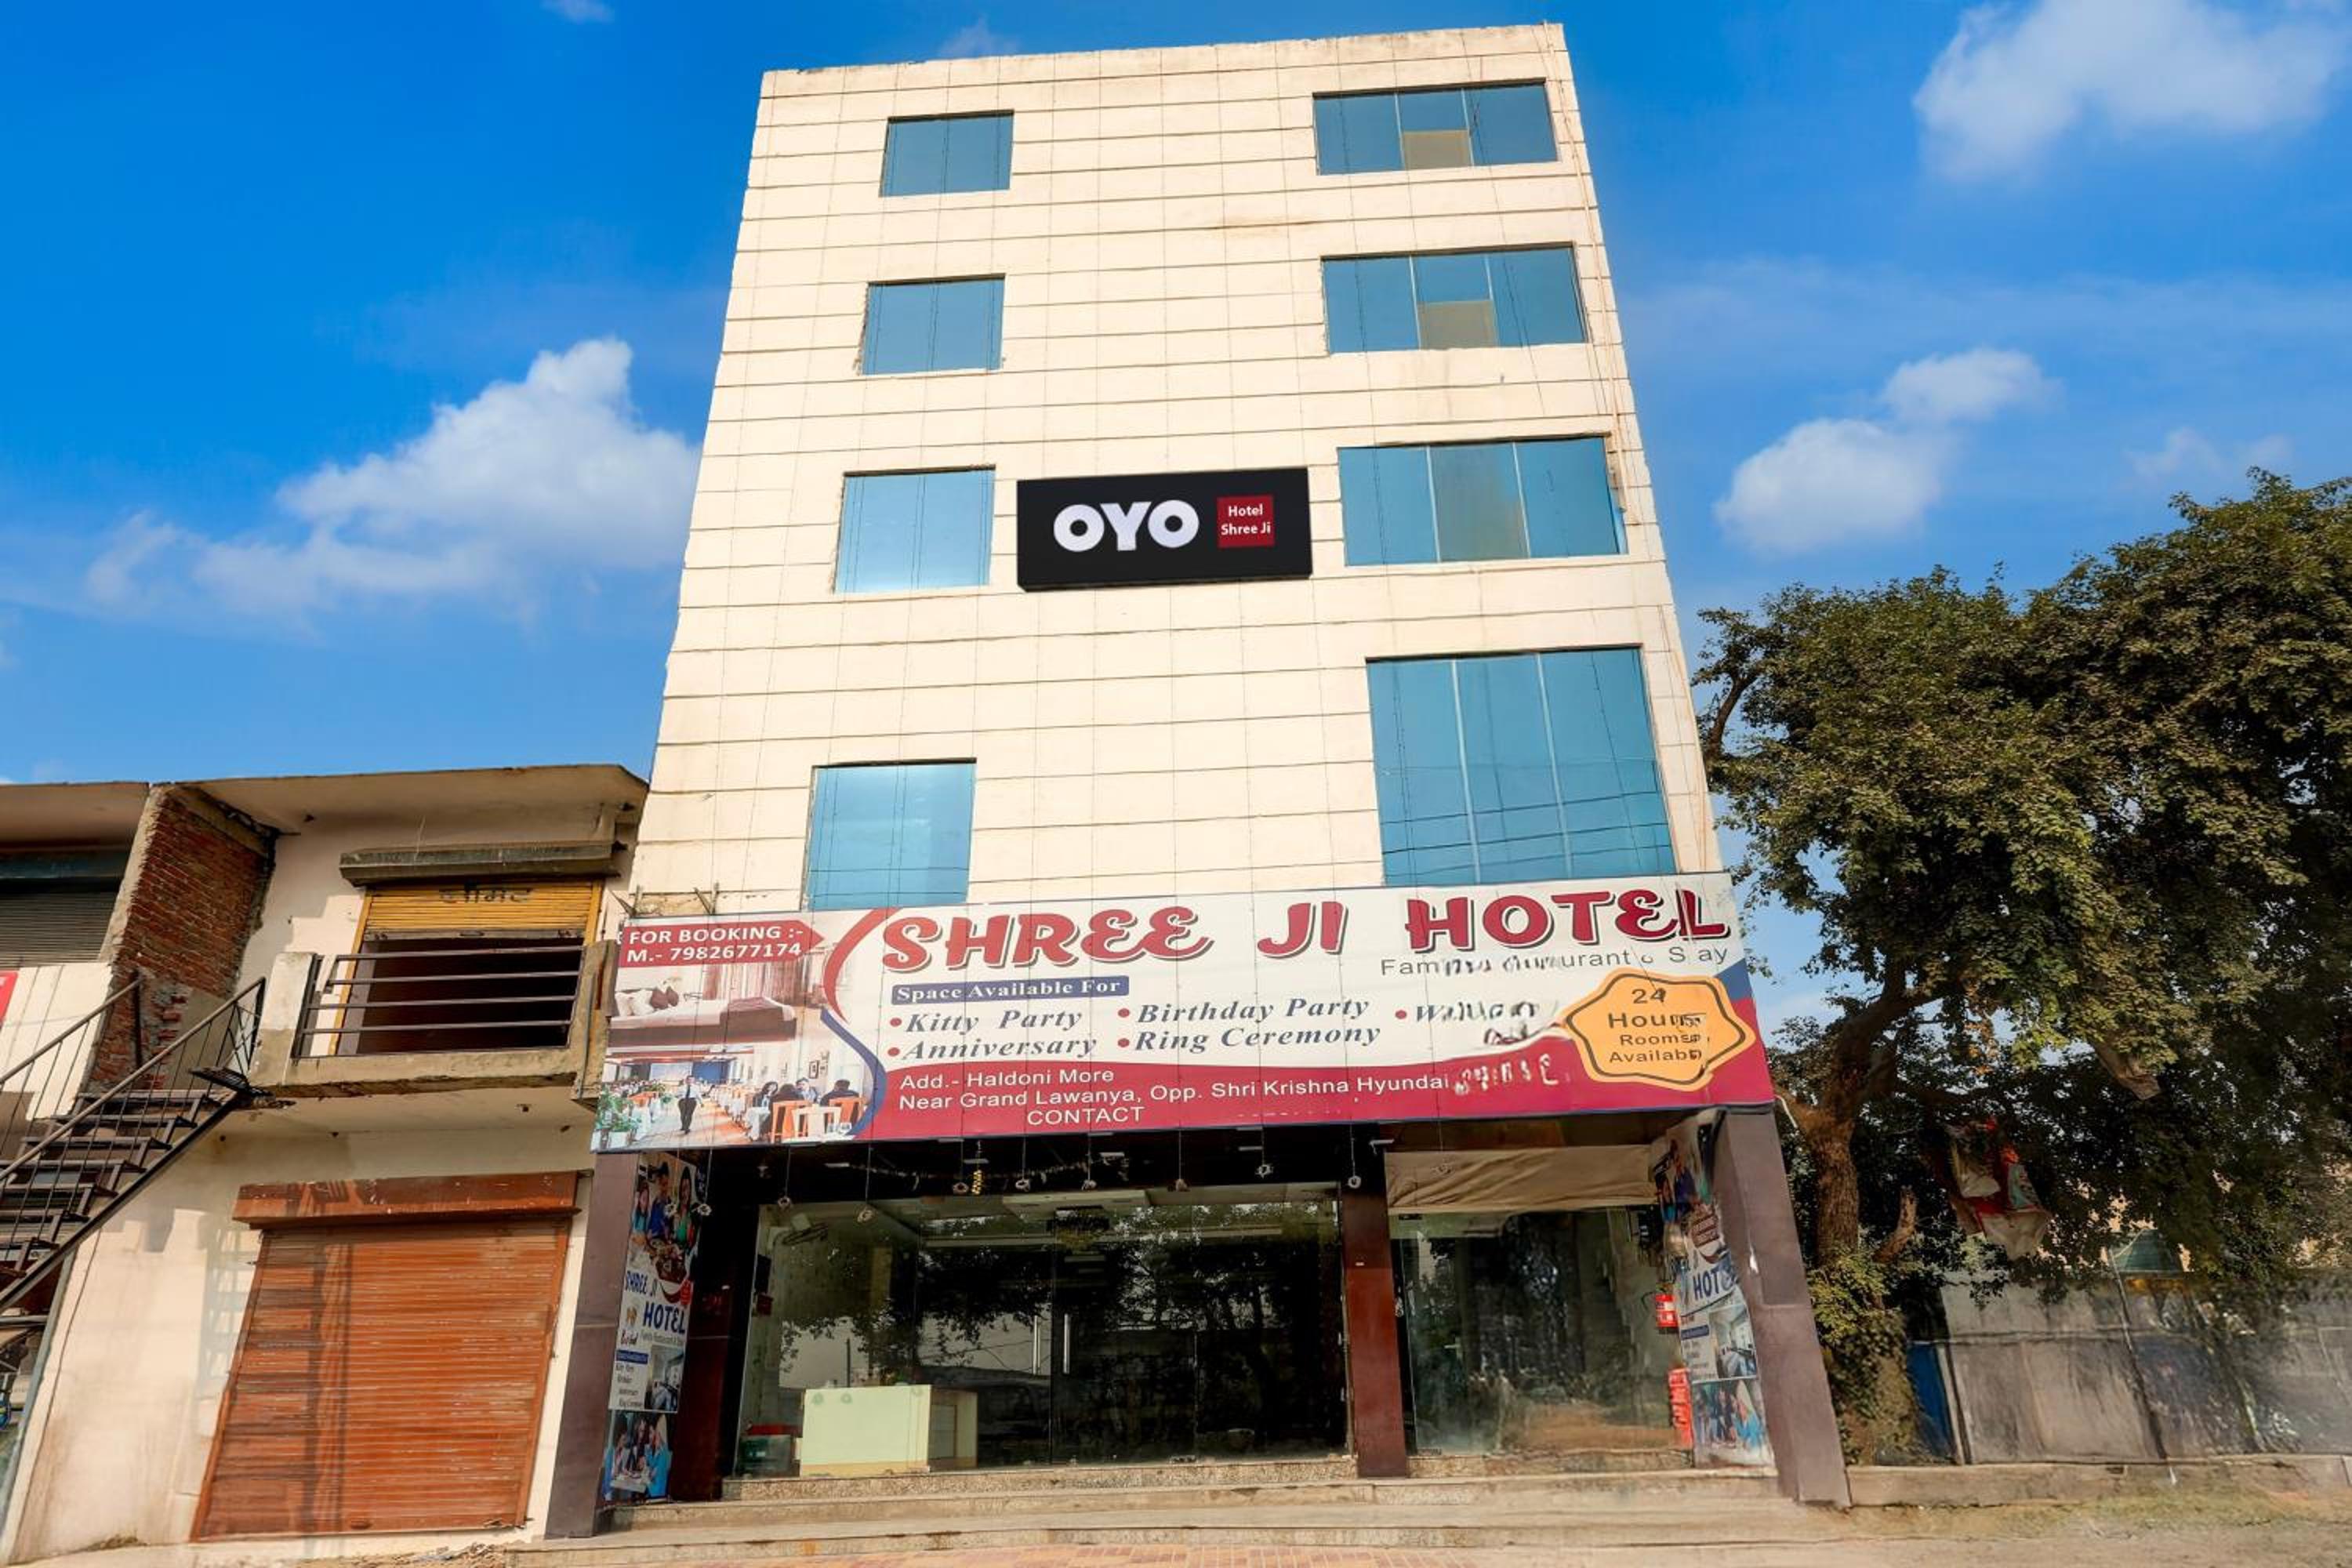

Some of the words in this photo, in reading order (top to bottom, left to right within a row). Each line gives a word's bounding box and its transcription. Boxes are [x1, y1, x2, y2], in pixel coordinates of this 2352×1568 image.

[1228, 503, 1263, 517] Hotel
[1053, 499, 1200, 552] OYO
[1221, 522, 1258, 536] Shree
[1261, 521, 1271, 535] Ji
[630, 930, 671, 945] FOR
[678, 926, 782, 942] BOOKING
[882, 906, 1214, 973] SHREE
[1257, 899, 1349, 957] JI
[1405, 889, 1730, 952] HOTEL
[670, 942, 801, 961] 7982677174
[897, 987, 962, 1003] Space
[968, 980, 1073, 998] Available
[1081, 979, 1120, 994] For
[1632, 988, 1667, 1004] 24
[1138, 1000, 1274, 1023] Birthday
[1286, 997, 1369, 1019] Party
[906, 1012, 979, 1035] Kitty
[999, 1009, 1082, 1031] Party
[902, 1038, 1097, 1059] Anniversary
[1134, 1031, 1209, 1054] Ring
[1221, 1026, 1381, 1047] Ceremony
[967, 1069, 1051, 1087] Haldoni
[1059, 1069, 1114, 1083] More
[899, 1094, 952, 1110] Near
[960, 1091, 1028, 1108] Grand
[1036, 1087, 1142, 1105] Lawanya,
[1150, 1084, 1202, 1101] Opp.
[1210, 1081, 1255, 1098] Shri
[1263, 1079, 1349, 1096] Krishna
[1357, 1073, 1449, 1094] Hyundai
[1027, 1106, 1145, 1126] CONTACT
[643, 1301, 686, 1334] HOTEL
